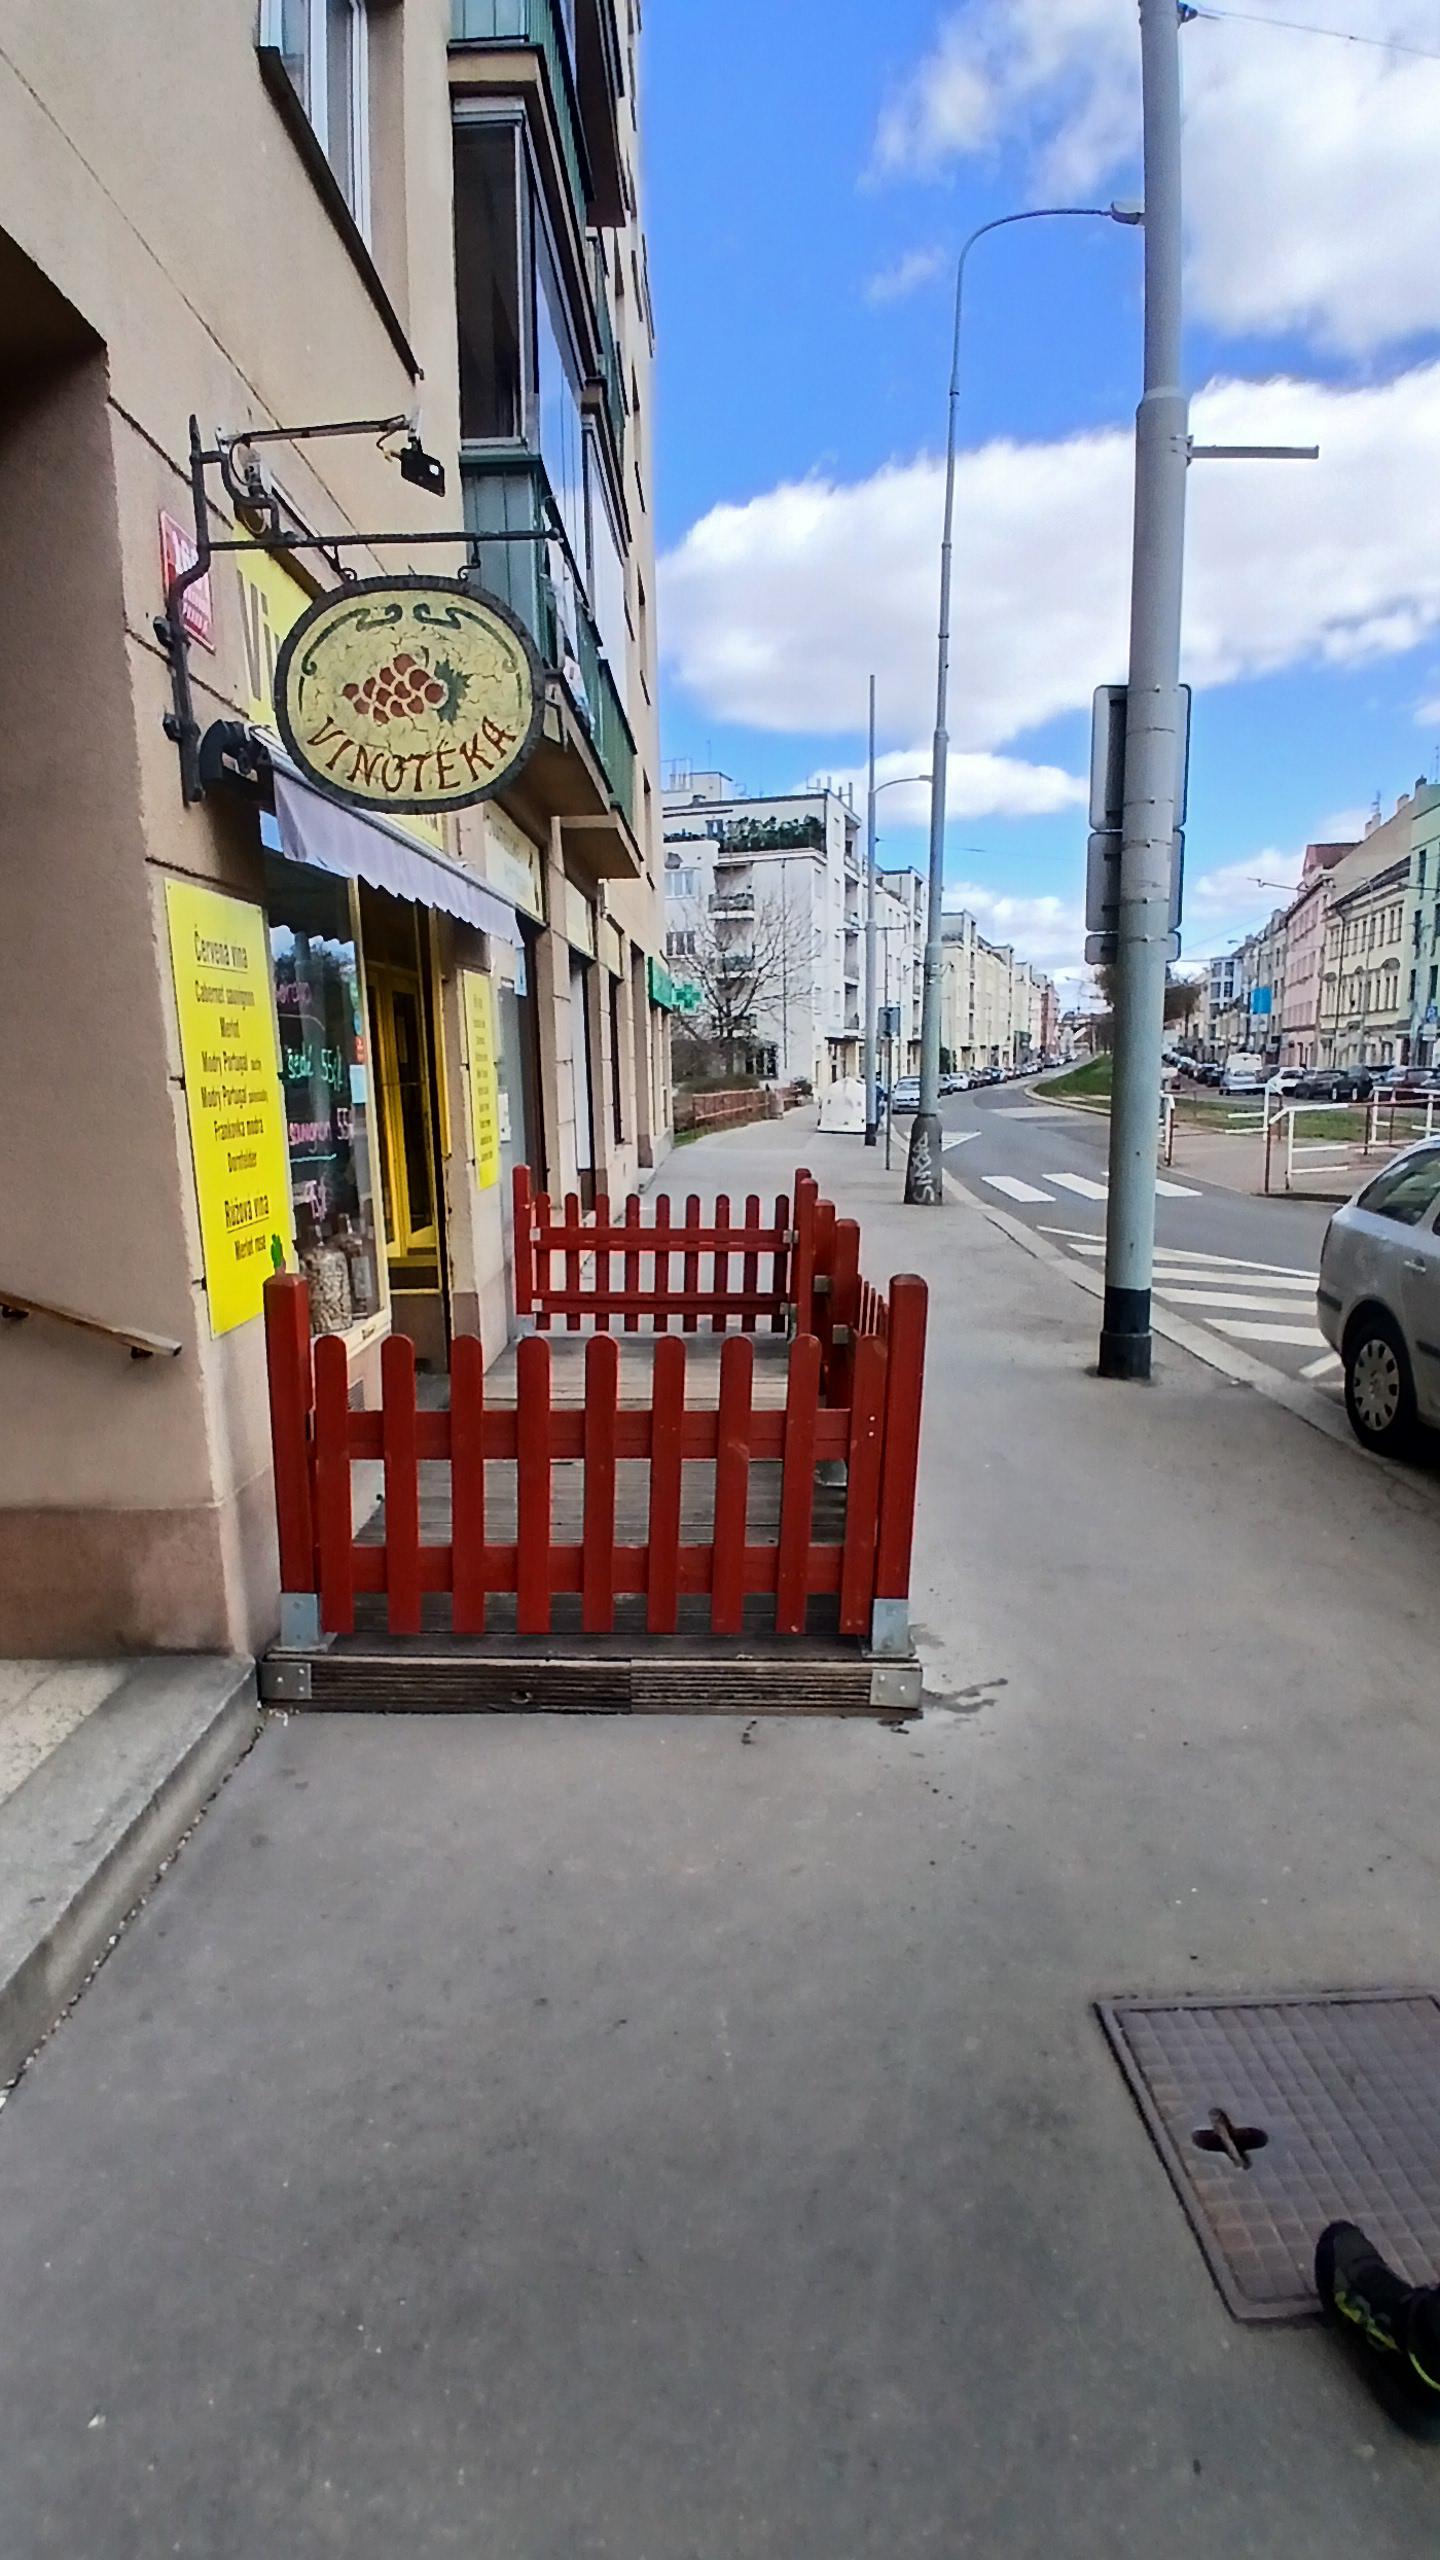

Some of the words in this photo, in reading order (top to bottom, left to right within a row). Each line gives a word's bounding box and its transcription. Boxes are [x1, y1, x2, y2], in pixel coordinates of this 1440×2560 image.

[219, 1016, 241, 1039] Merlot
[222, 1050, 248, 1076] Portugal
[222, 1085, 247, 1109] Portugal
[213, 1118, 245, 1141] Frankovka
[234, 1234, 254, 1260] Merlot
